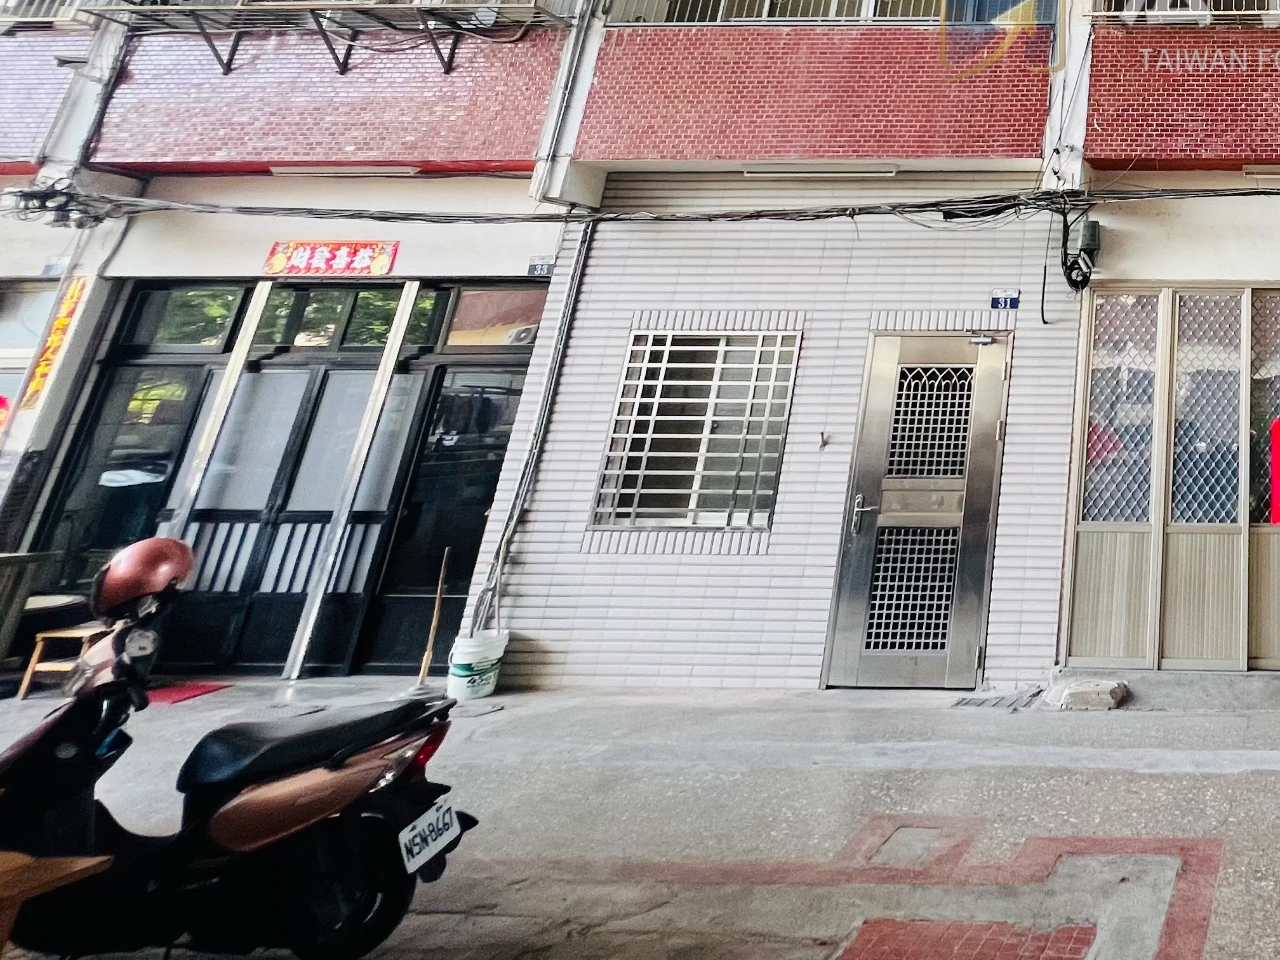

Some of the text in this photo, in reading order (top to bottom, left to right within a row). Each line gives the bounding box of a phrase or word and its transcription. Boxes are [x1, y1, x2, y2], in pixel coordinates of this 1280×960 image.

[534, 265, 548, 275] 33
[998, 297, 1011, 309] 31
[403, 805, 454, 864] NSN-8667
